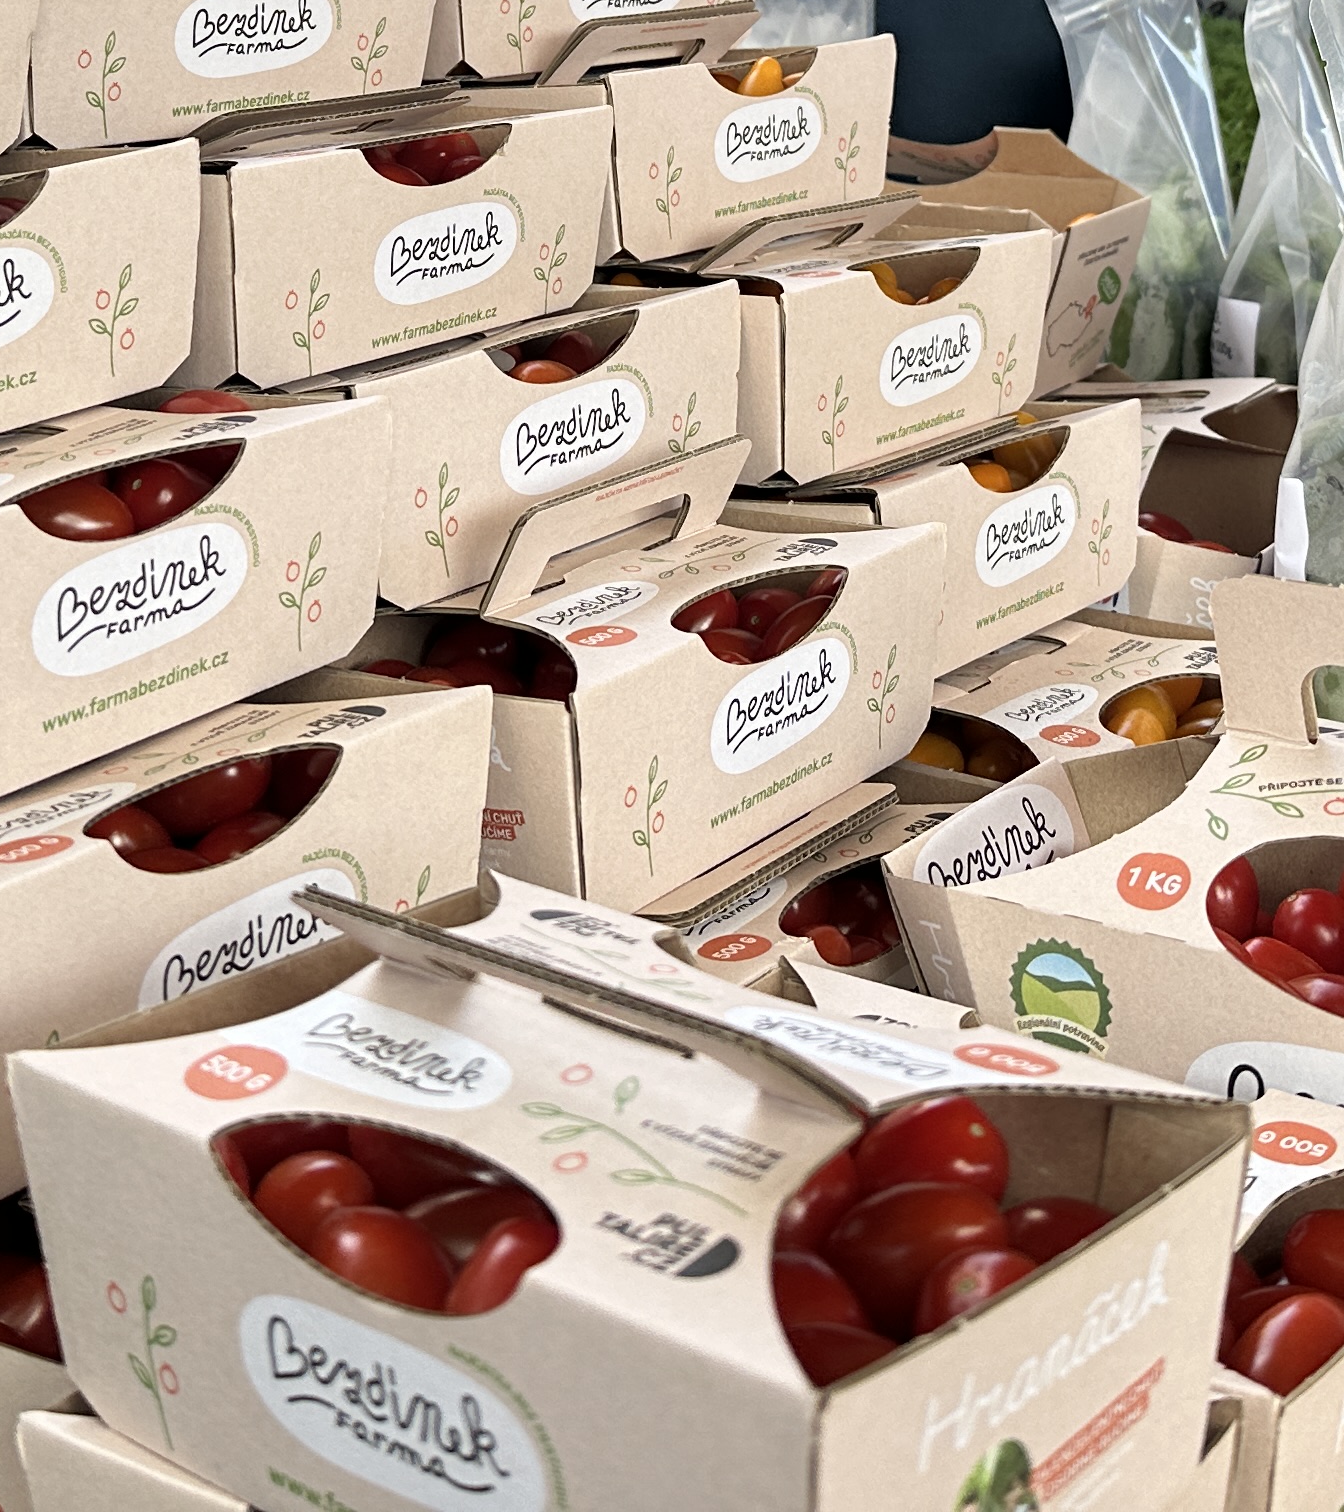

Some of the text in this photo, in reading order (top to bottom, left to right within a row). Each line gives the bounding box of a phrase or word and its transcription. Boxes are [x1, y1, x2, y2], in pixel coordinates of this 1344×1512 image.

[171, 89, 311, 118] www.farmabezdinek.cz
[371, 306, 499, 349] www.farmabezdinek.cz
[41, 650, 230, 734] www.farmabezdinek.cz
[709, 751, 834, 830] www.farmabezdinek.cz
[1258, 776, 1324, 793] PŘIPOJTE
[1325, 776, 1343, 786] SE
[1128, 866, 1183, 897] 1 KG
[711, 940, 746, 961] 500
[198, 1054, 254, 1084] 500
